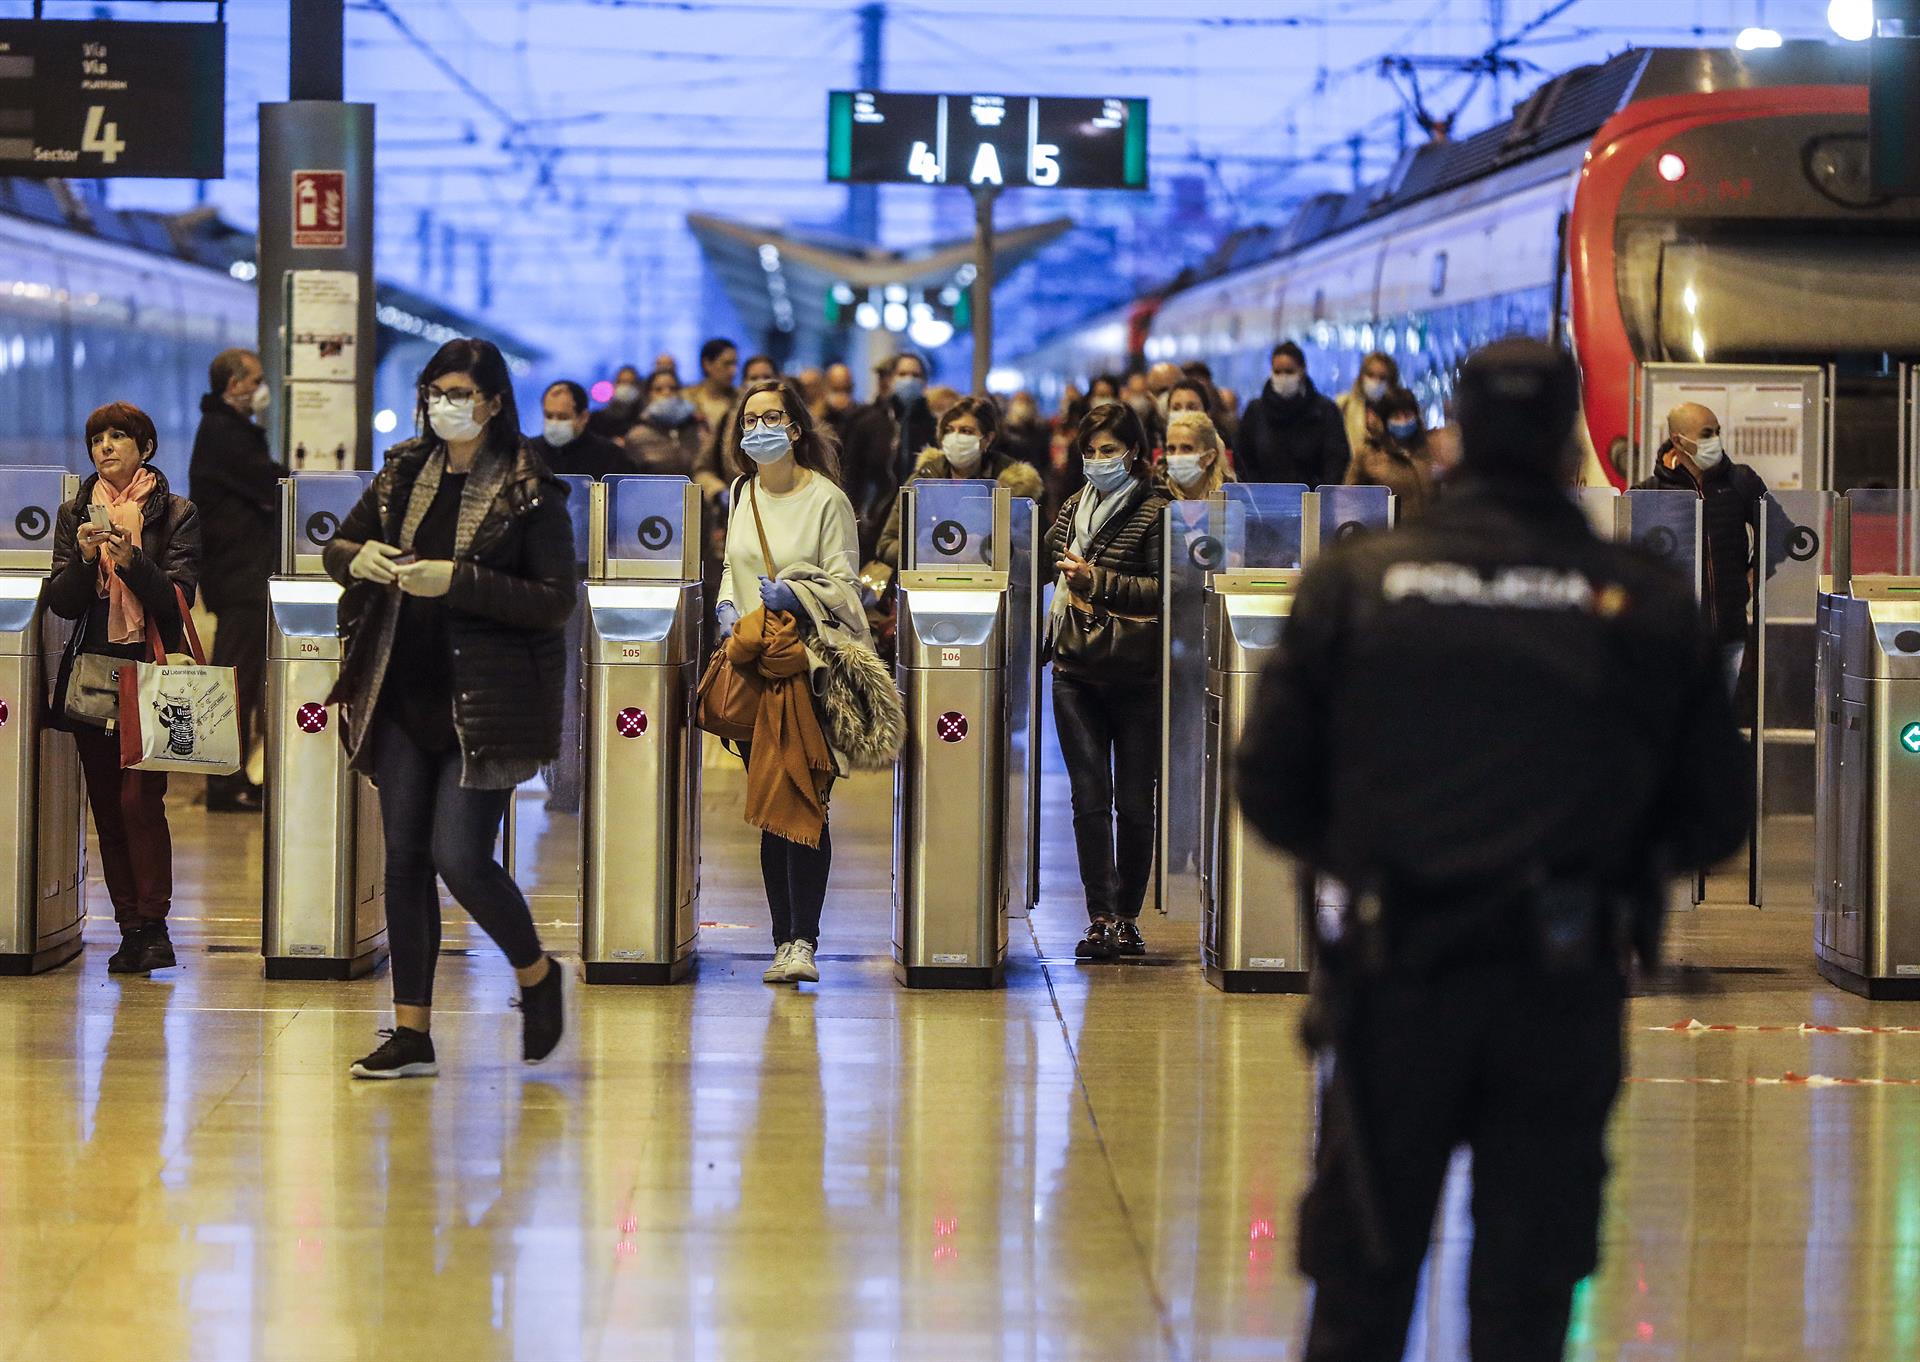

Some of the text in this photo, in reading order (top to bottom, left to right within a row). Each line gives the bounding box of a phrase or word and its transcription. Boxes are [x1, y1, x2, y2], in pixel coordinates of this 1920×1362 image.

[82, 106, 126, 163] 4
[908, 141, 941, 183] 4
[970, 142, 1003, 185] A
[1032, 143, 1060, 186] 5
[300, 643, 320, 654] 104
[623, 649, 640, 657] 105
[943, 653, 961, 661] 106
